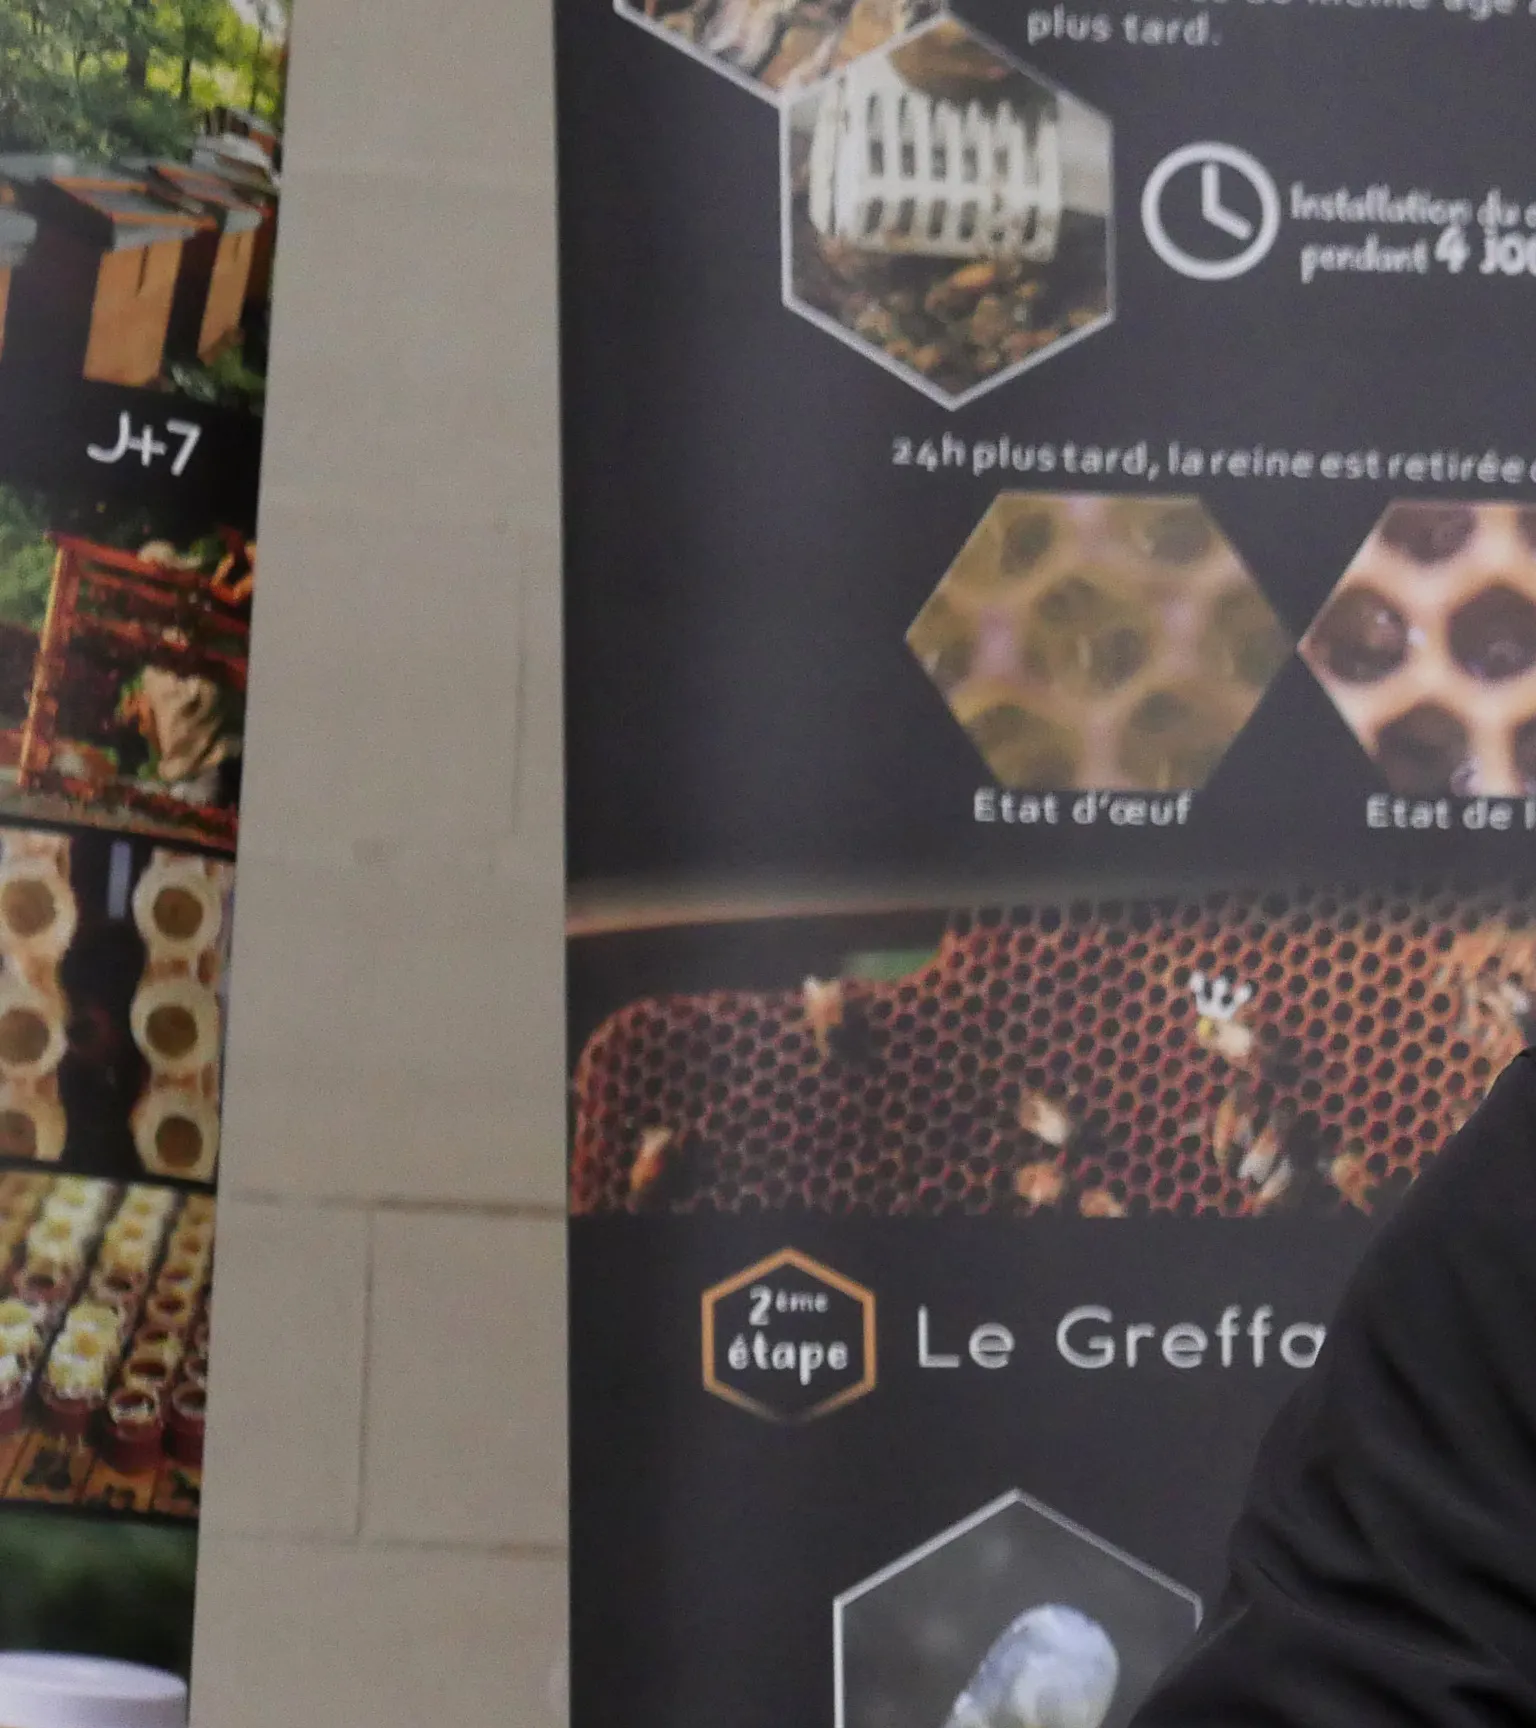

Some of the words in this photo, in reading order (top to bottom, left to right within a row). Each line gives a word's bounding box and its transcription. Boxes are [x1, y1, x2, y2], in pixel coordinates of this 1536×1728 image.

[1027, 2, 1112, 46] plus
[1289, 179, 1473, 226] Installation
[1301, 231, 1429, 284] pendant
[1434, 222, 1471, 275] 4
[87, 410, 203, 476] J+7
[891, 430, 967, 474] 24h
[972, 432, 1058, 478] plus
[1061, 439, 1161, 482] tard,
[1167, 439, 1204, 475] la
[1210, 443, 1314, 478] reine
[1320, 447, 1381, 481] est
[1387, 446, 1525, 484] retirée
[972, 787, 1058, 825] Etat
[1365, 793, 1450, 830] Etat
[1462, 796, 1513, 831] de
[726, 1330, 849, 1386] étape
[917, 1304, 1016, 1369] Le
